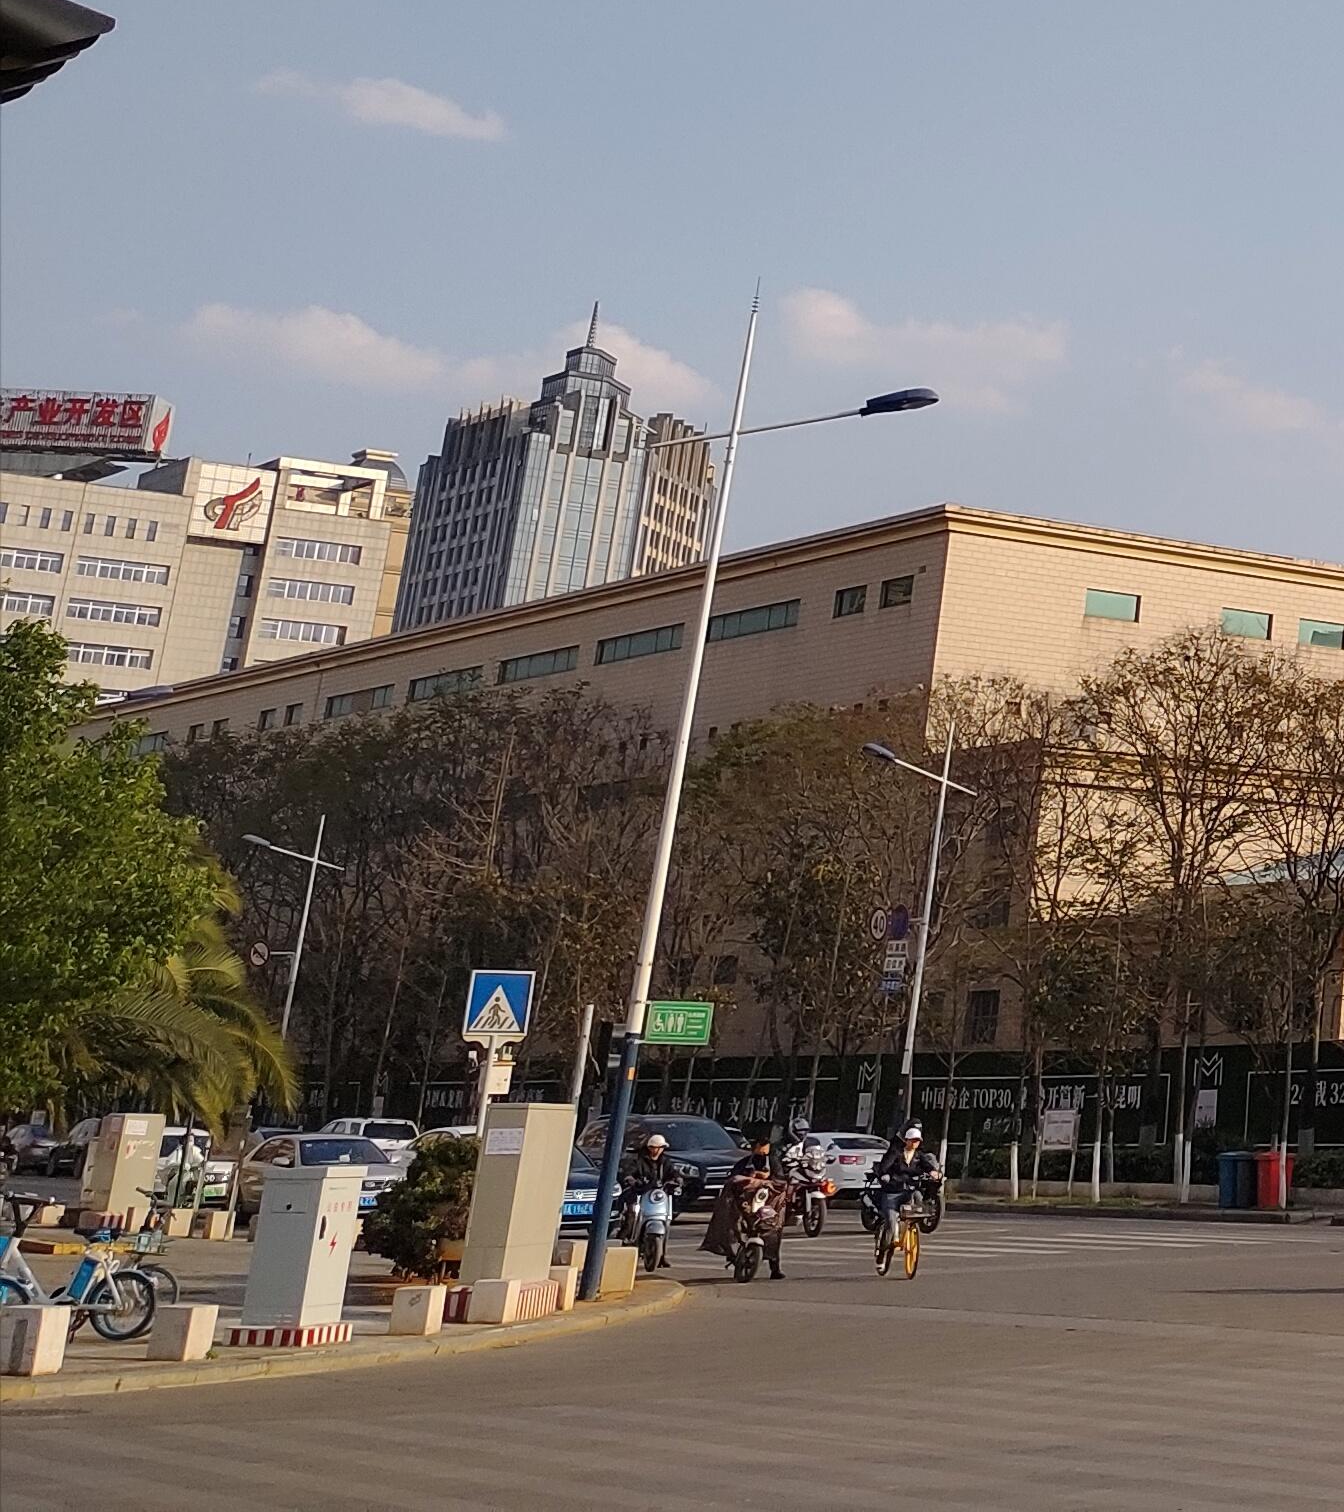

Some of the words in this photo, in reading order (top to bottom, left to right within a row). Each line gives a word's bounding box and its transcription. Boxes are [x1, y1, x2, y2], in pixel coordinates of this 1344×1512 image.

[0, 394, 148, 428] 产业开发区
[872, 915, 885, 934] 40
